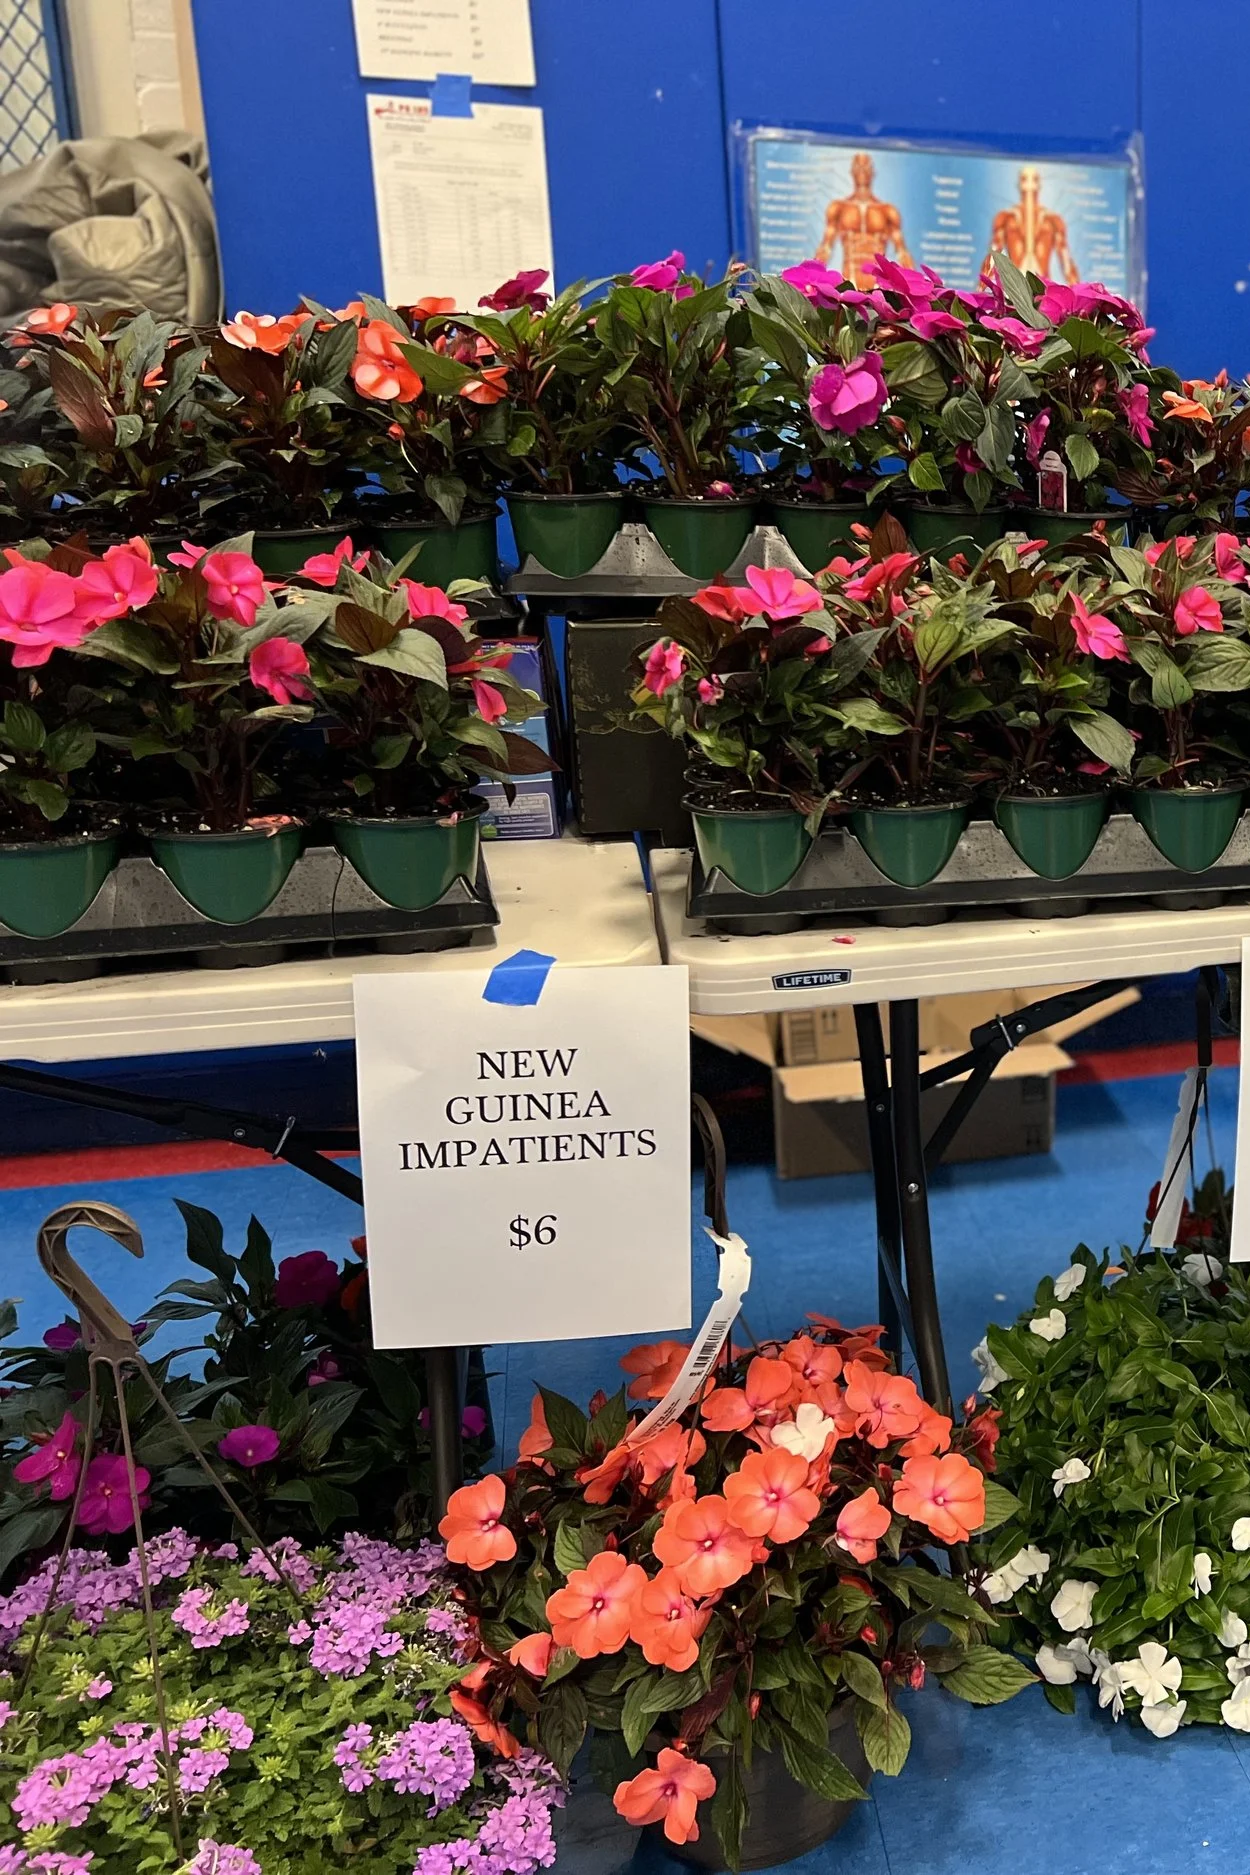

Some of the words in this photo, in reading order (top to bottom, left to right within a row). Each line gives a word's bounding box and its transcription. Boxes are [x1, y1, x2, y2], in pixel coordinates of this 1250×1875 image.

[783, 973, 842, 986] LIFETIME
[476, 1048, 578, 1080] NEW
[445, 1090, 612, 1125] GUINEA
[398, 1128, 657, 1170] IMPATIENTS
[509, 1214, 558, 1250] $6
